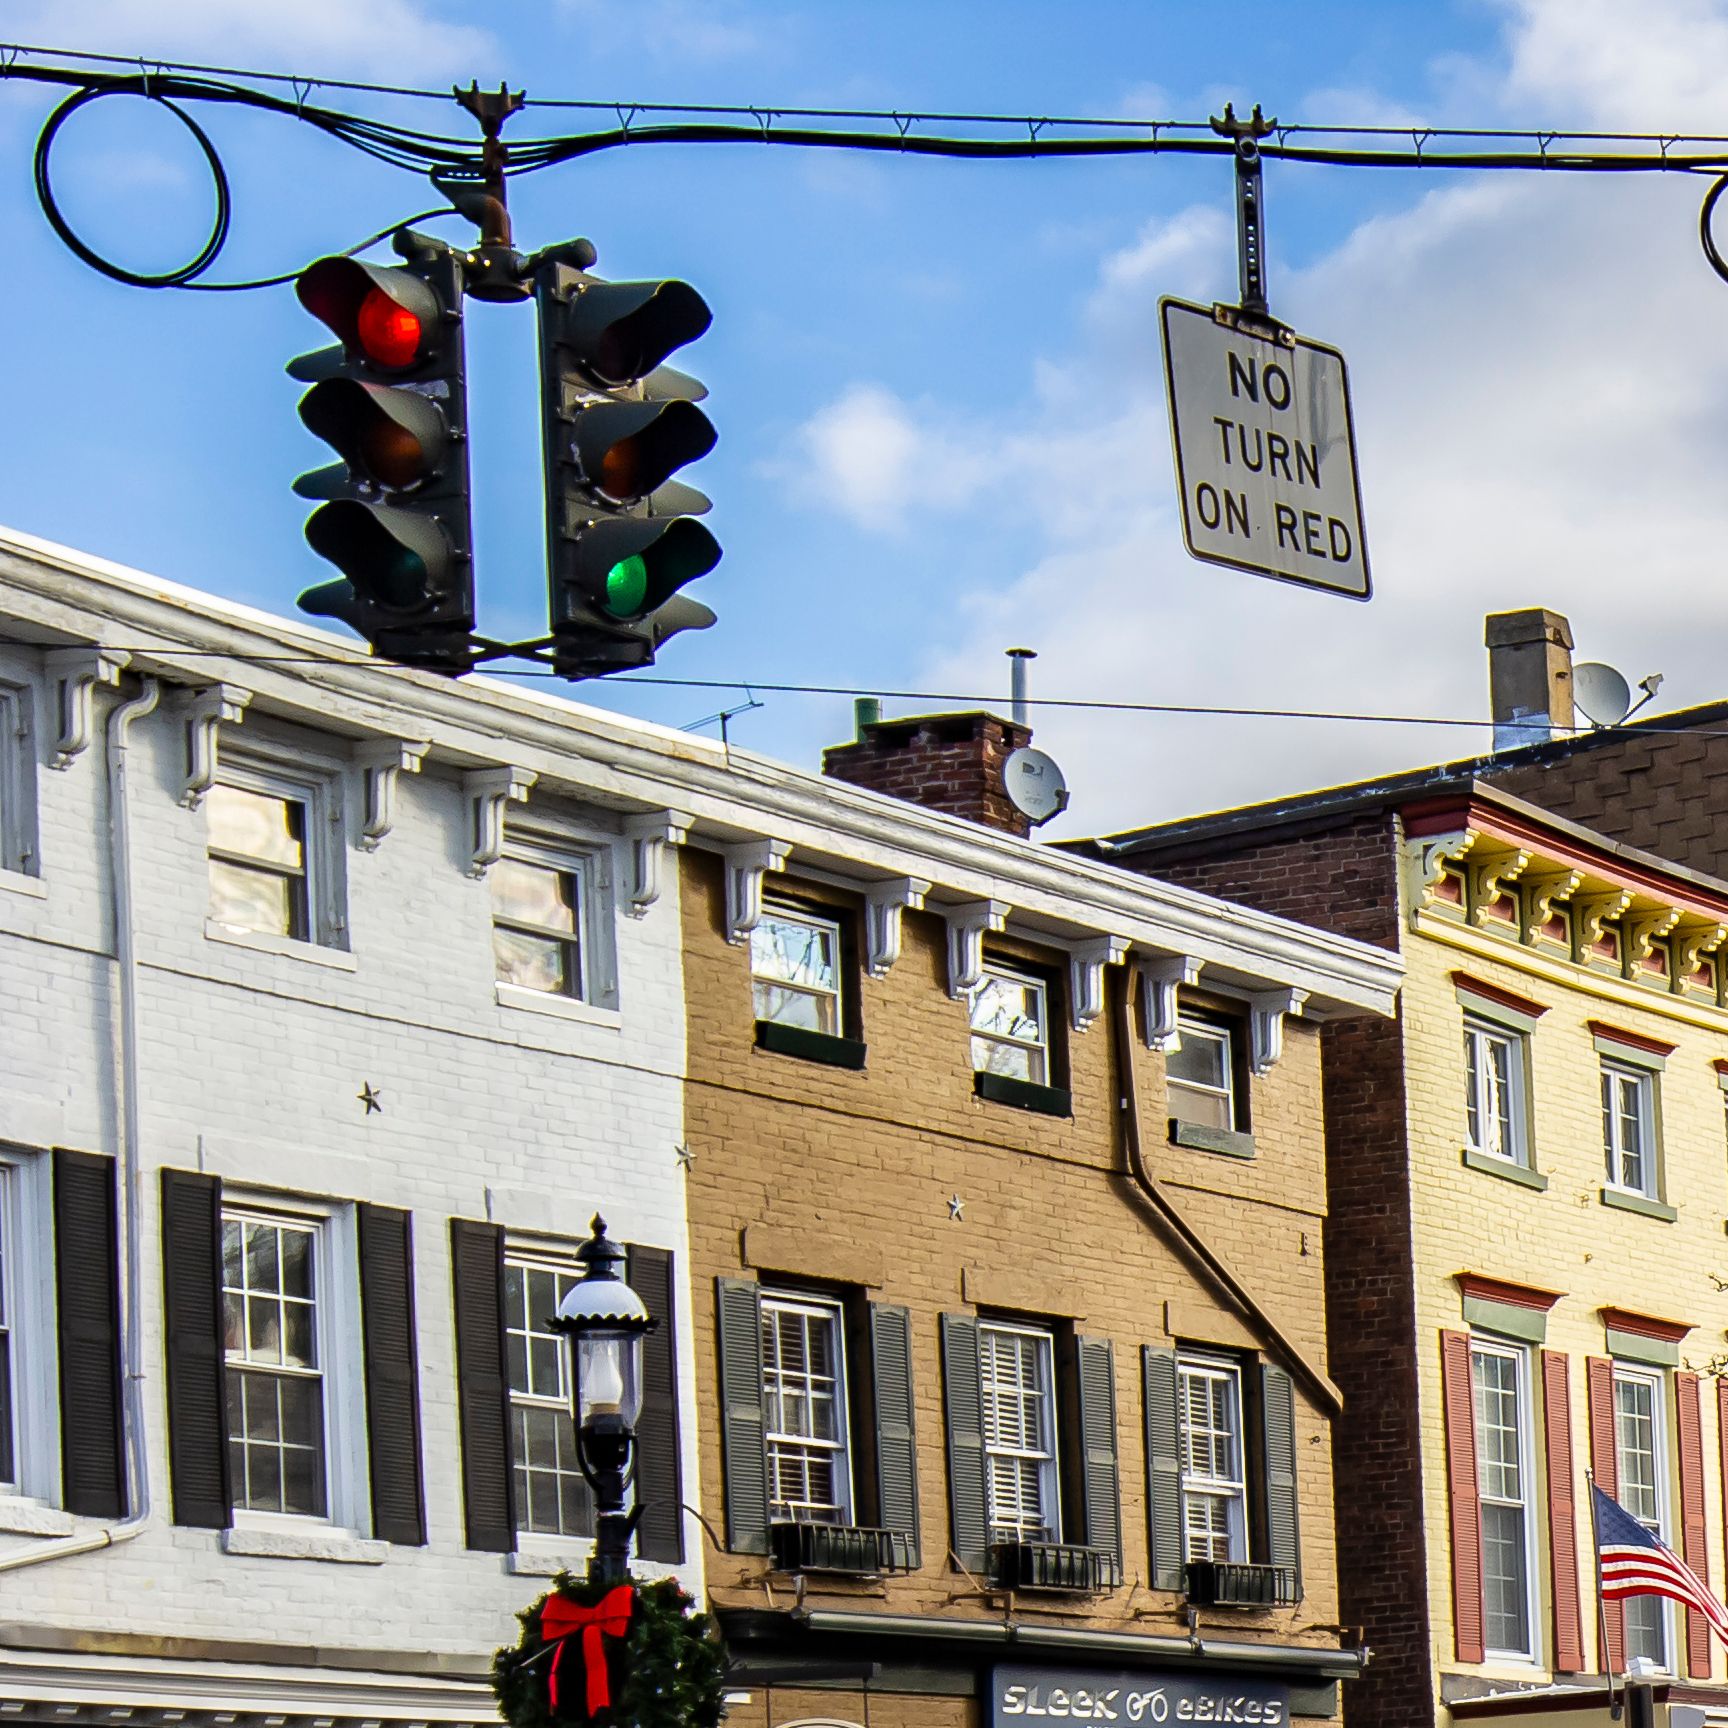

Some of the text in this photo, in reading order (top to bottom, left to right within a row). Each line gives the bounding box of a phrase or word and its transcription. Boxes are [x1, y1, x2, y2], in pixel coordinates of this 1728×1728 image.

[1227, 351, 1292, 411] NO
[1213, 416, 1321, 489] TURN
[1195, 481, 1251, 539] ON
[1274, 502, 1352, 563] RED
